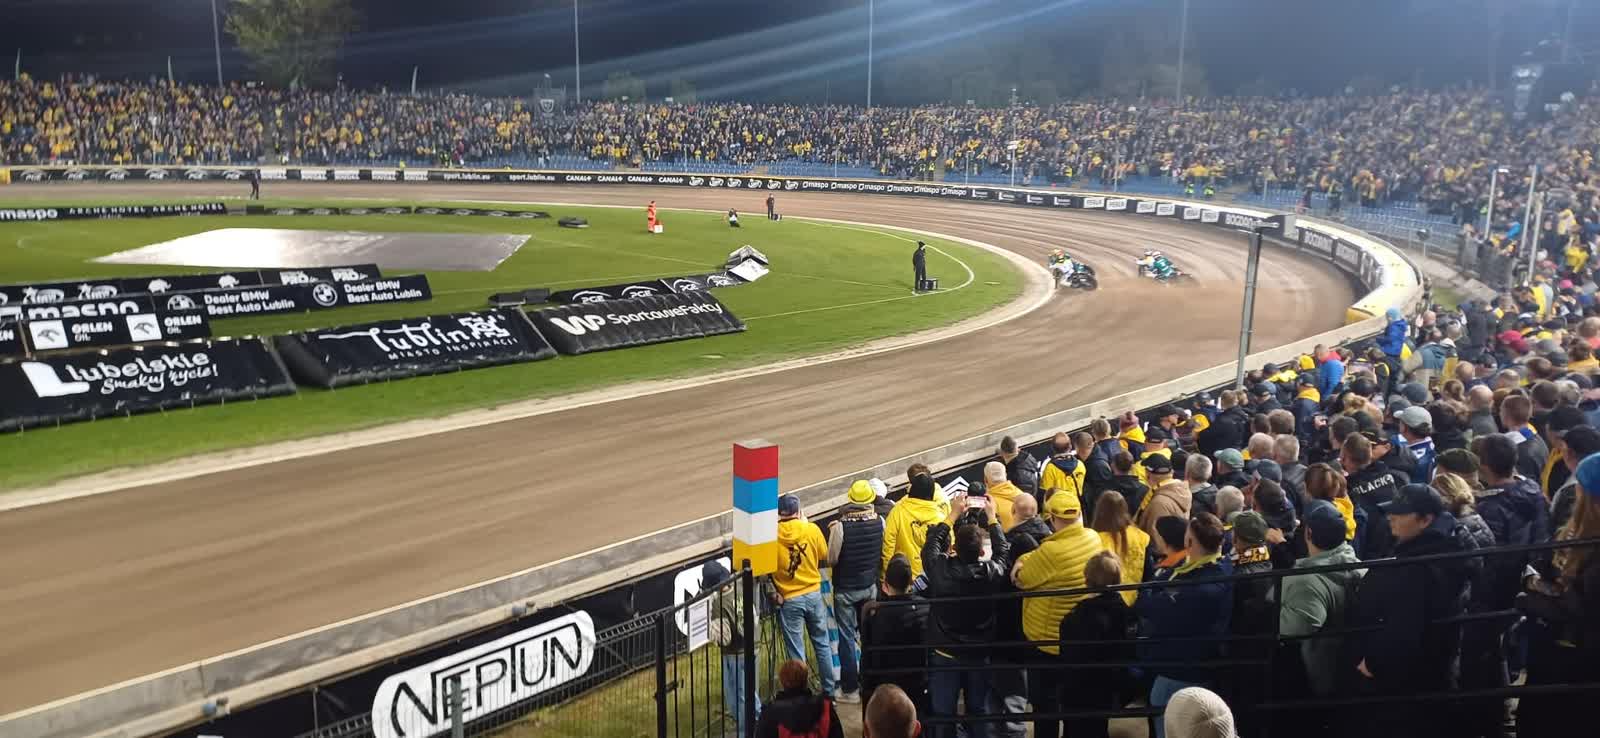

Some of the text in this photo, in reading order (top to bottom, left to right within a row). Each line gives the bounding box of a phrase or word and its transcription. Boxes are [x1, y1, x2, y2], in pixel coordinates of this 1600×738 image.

[808, 181, 829, 189] maspo
[920, 186, 940, 194] maspo
[947, 188, 967, 196] maspo
[0, 208, 58, 221] maspo
[344, 280, 400, 293] Dealer BMW
[204, 289, 270, 304] Dealer BMW
[347, 288, 422, 303] Best Auto Lublin
[207, 299, 295, 315] Best Auto Lublin
[165, 314, 202, 327] ORLEN
[550, 315, 606, 335] WP
[72, 321, 113, 334] ORLEN
[389, 348, 440, 361] MIASTO
[391, 622, 583, 737] NEPTUN
